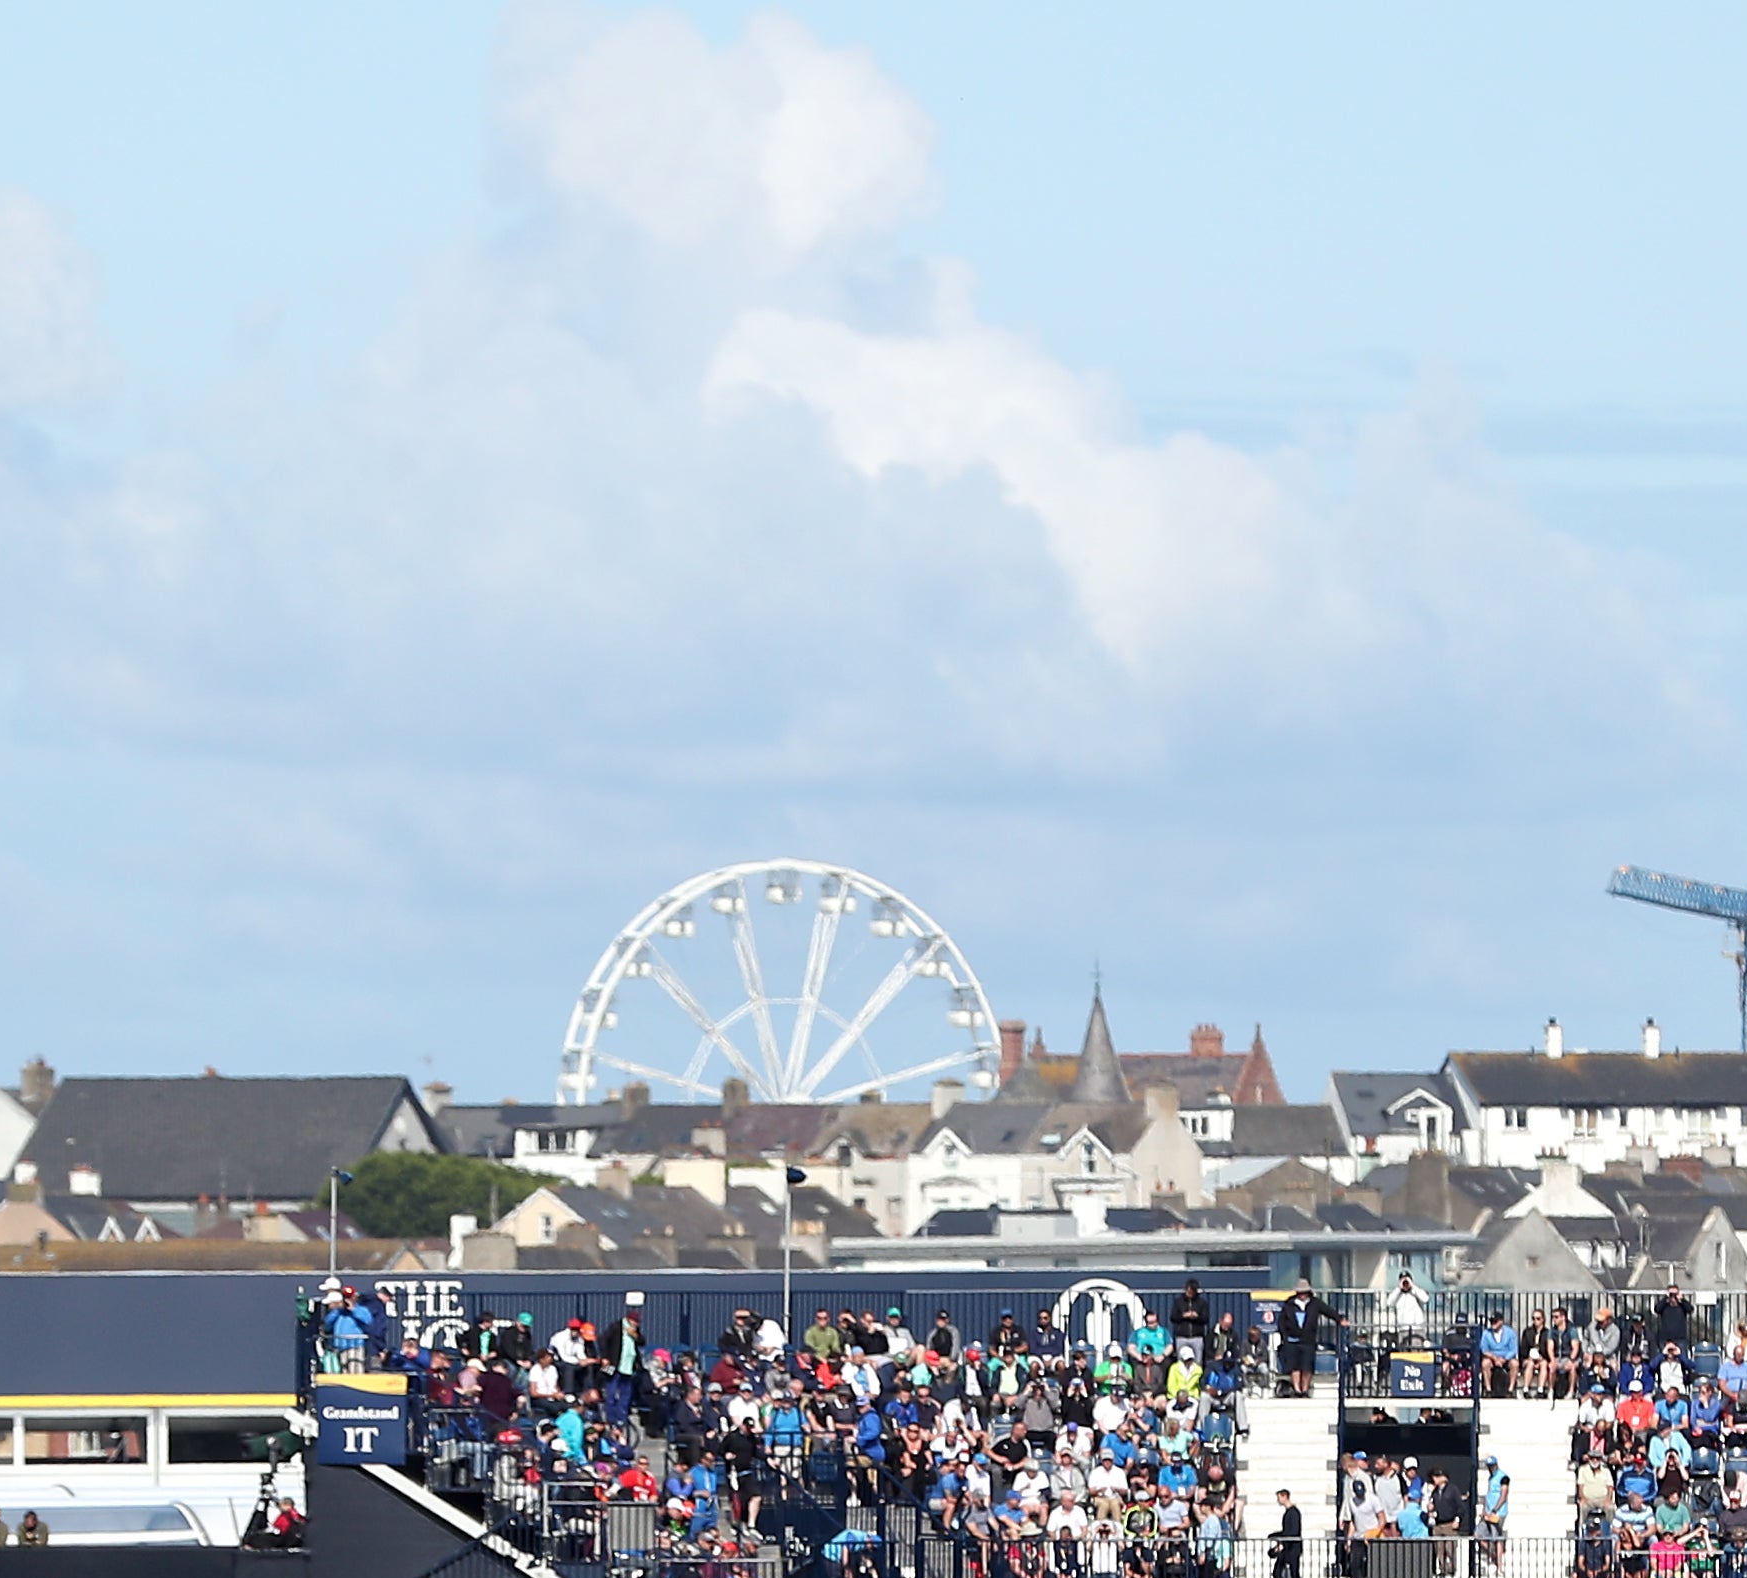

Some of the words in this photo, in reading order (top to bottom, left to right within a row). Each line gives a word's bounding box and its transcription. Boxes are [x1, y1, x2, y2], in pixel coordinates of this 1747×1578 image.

[374, 1280, 464, 1317] THE
[1404, 1365, 1421, 1377] No
[1400, 1379, 1424, 1391] Exit
[322, 1406, 400, 1420] Grandstand
